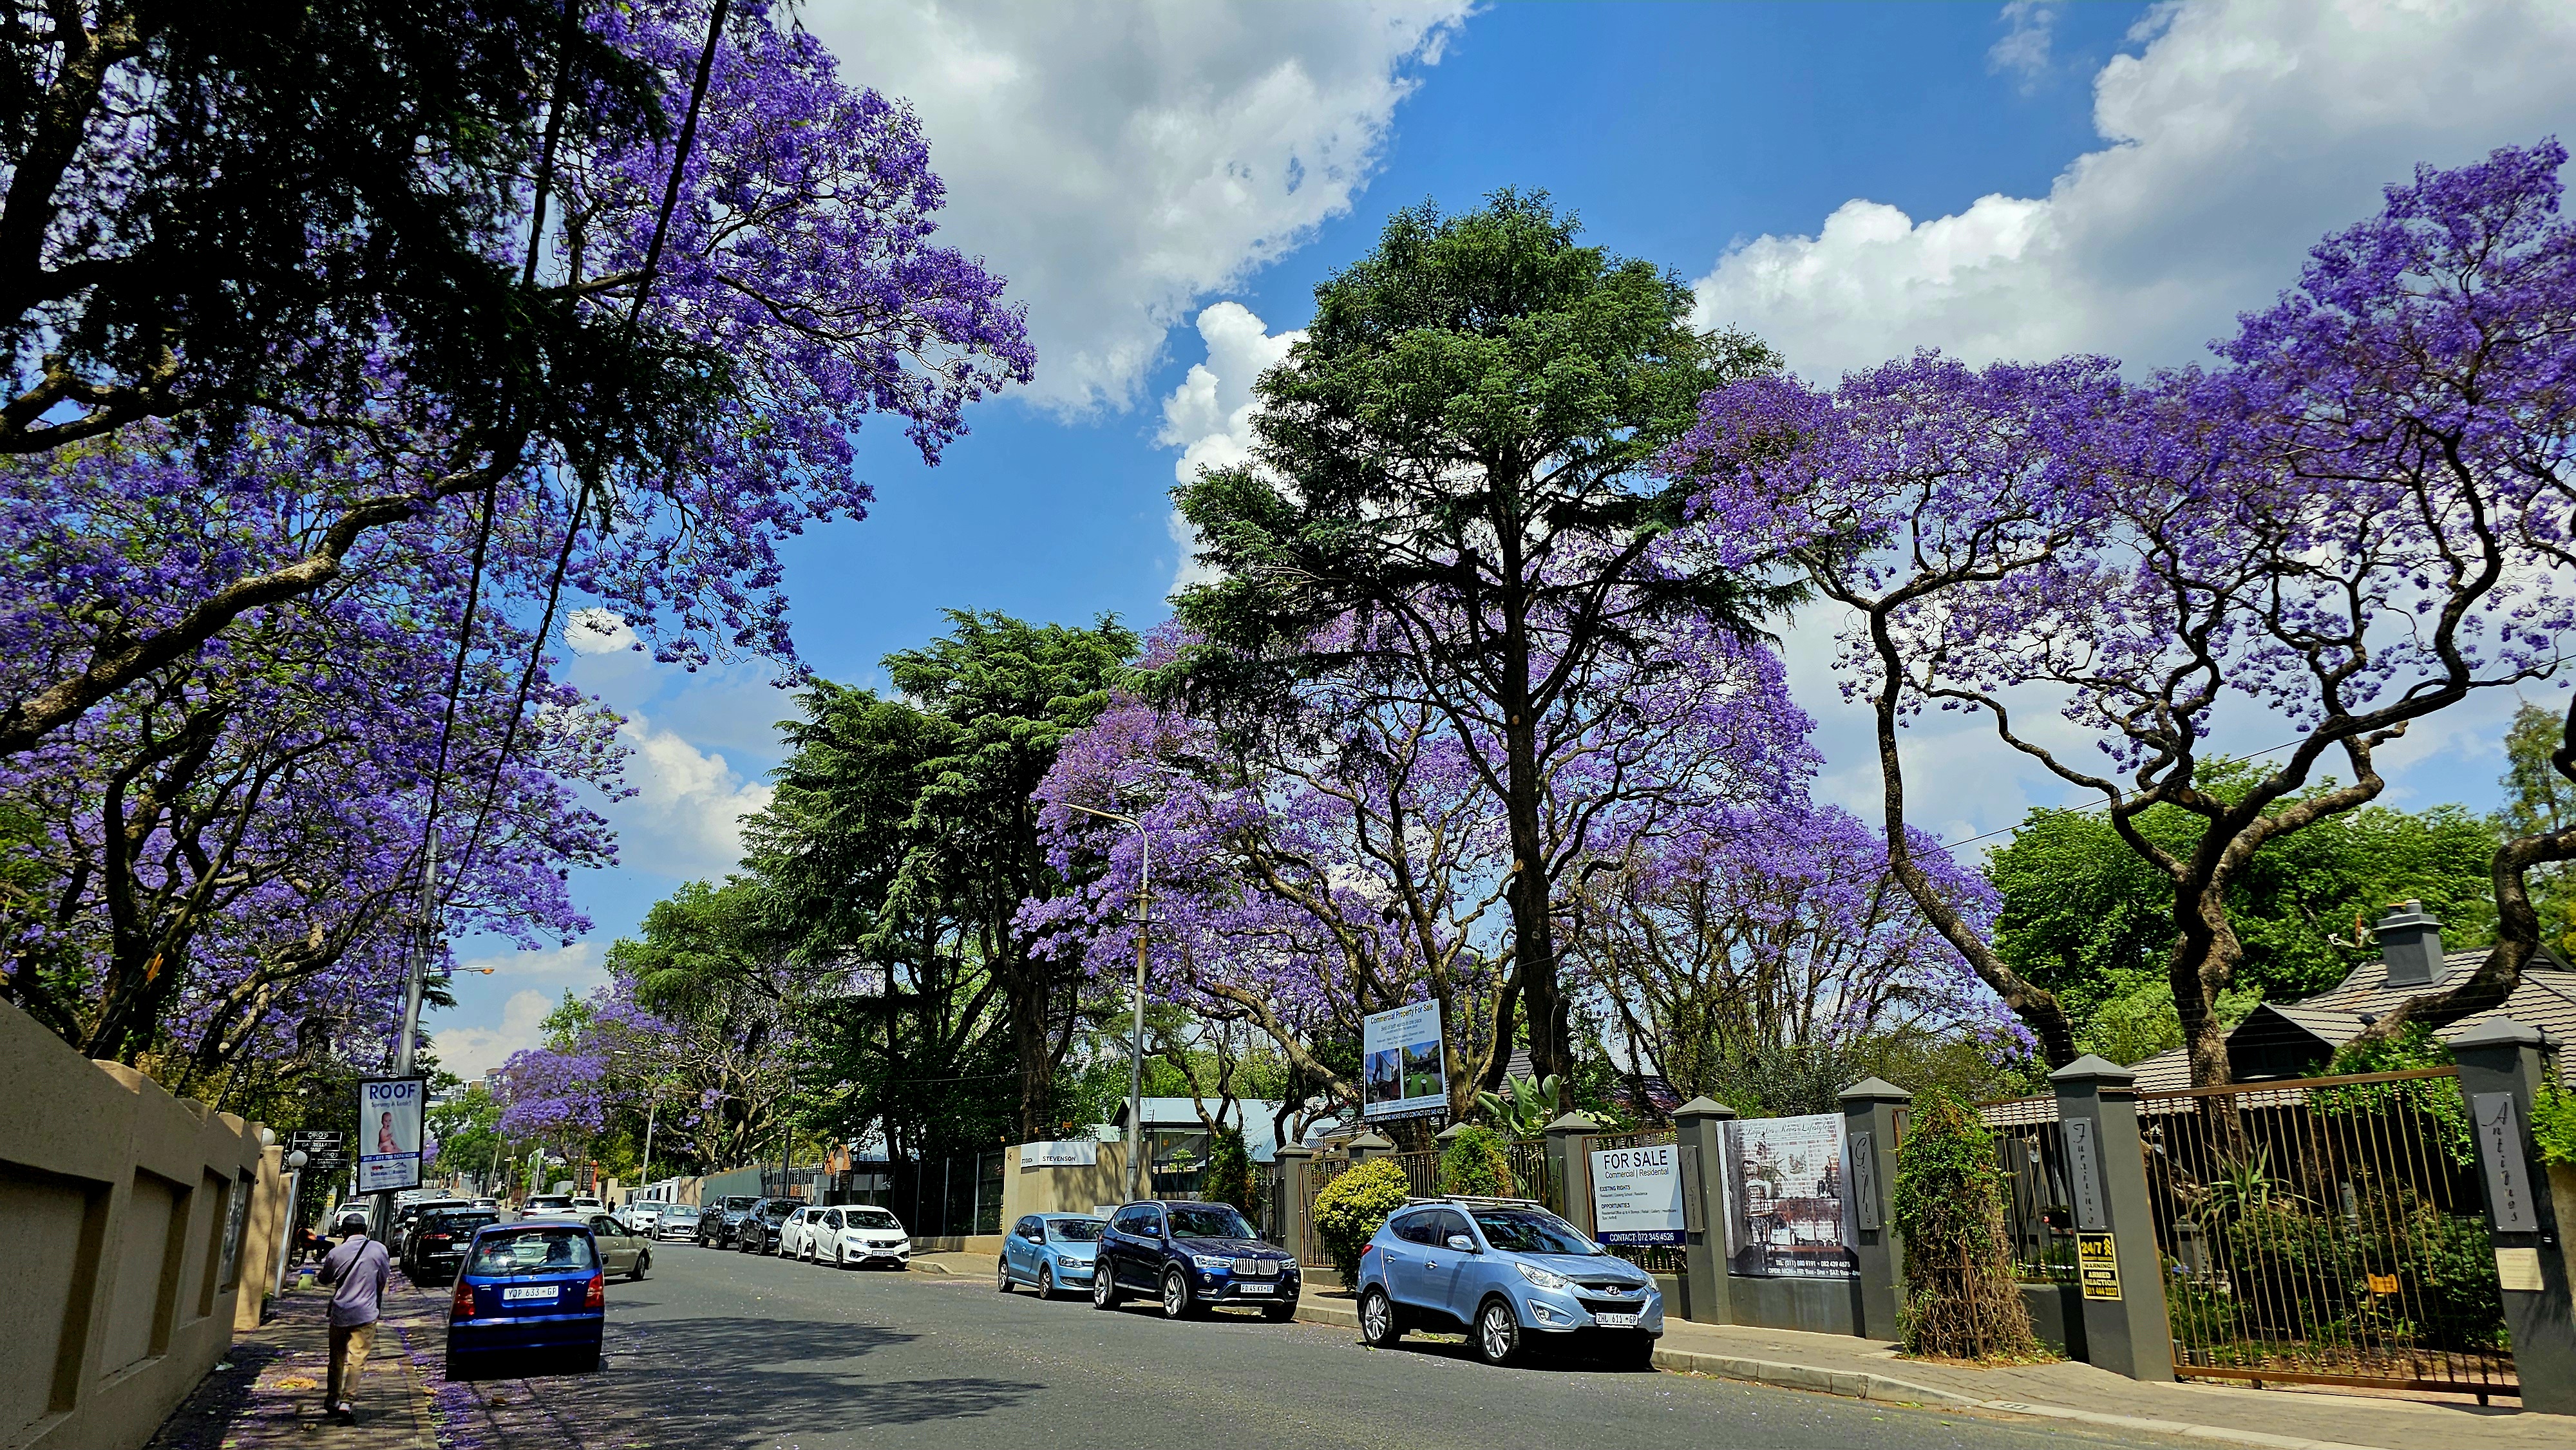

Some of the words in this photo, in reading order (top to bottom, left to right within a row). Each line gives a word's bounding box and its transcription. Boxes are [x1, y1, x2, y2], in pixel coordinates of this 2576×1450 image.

[1370, 1012, 1395, 1024] Commercial
[1396, 1008, 1414, 1019] Property
[1423, 1003, 1433, 1012] Sale
[370, 1084, 415, 1100] ROOF
[1802, 1120, 1829, 1134] Lifestyle
[1604, 1153, 1630, 1170] FOR
[1634, 1149, 1668, 1167] SALE
[2481, 1101, 2517, 1221] Antiques
[1605, 1170, 1635, 1179] Commercial
[1639, 1167, 1669, 1176] Residential
[1609, 1233, 1637, 1242] CONTACT:
[1638, 1233, 1648, 1241] 072
[1649, 1232, 1659, 1241] 345
[1660, 1232, 1674, 1241] 4526
[2081, 1241, 2102, 1256] 24/7
[1784, 1259, 1796, 1268] (011)
[526, 1288, 540, 1297] 633
[547, 1287, 556, 1295] GP
[1612, 1314, 1622, 1323] 611
[1629, 1315, 1636, 1324] GP
